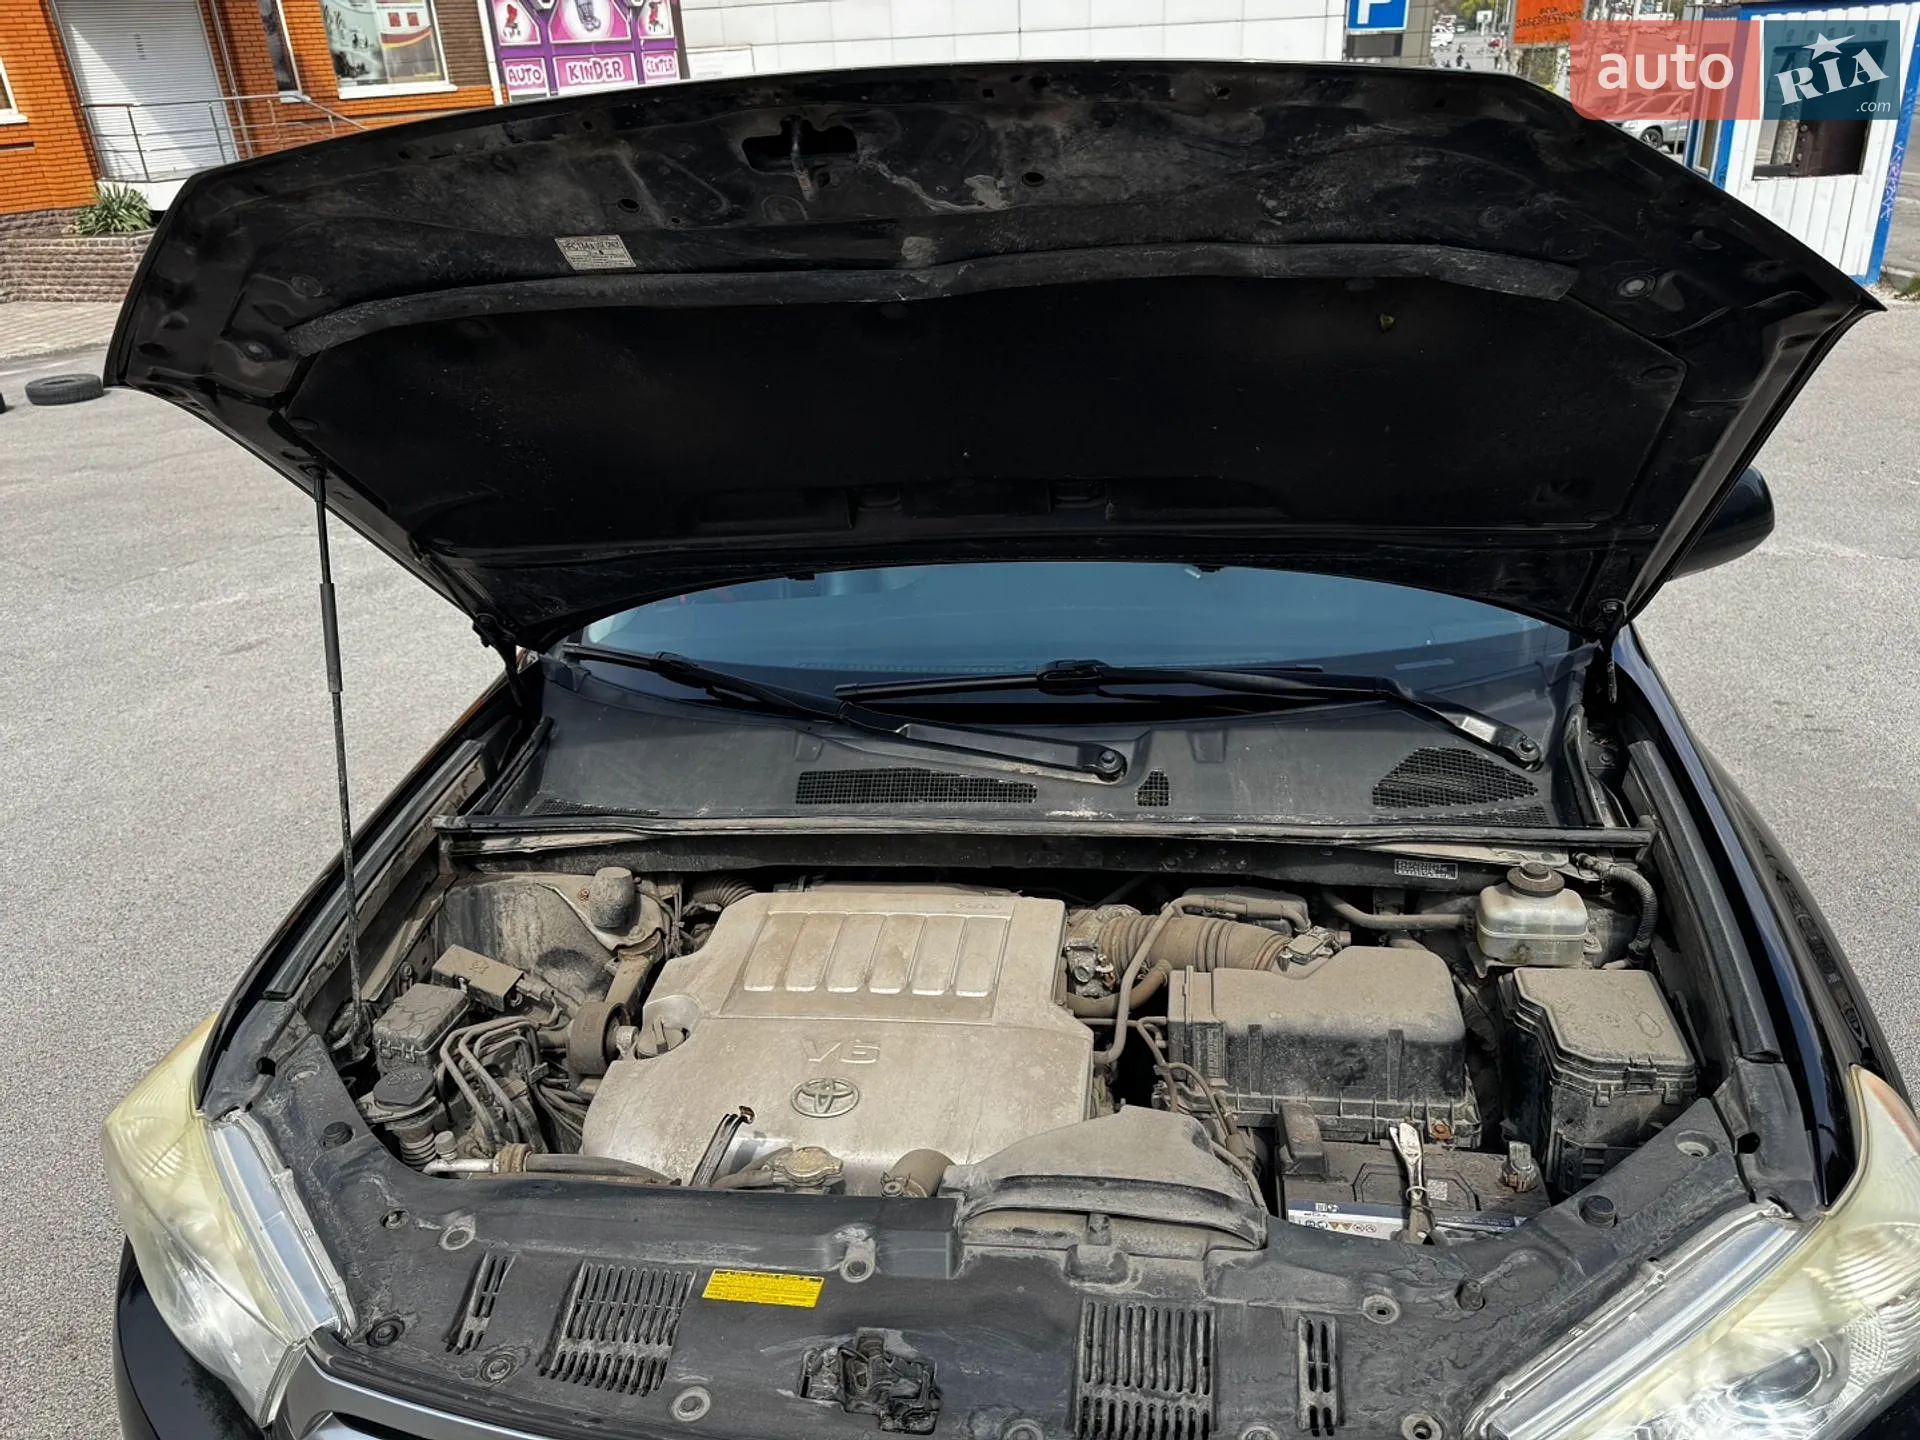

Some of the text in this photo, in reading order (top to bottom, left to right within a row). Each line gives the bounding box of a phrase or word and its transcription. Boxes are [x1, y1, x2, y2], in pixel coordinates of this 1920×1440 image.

[508, 57, 675, 84] AUTO KINDER CENTER
[800, 1038, 881, 1064] V6
